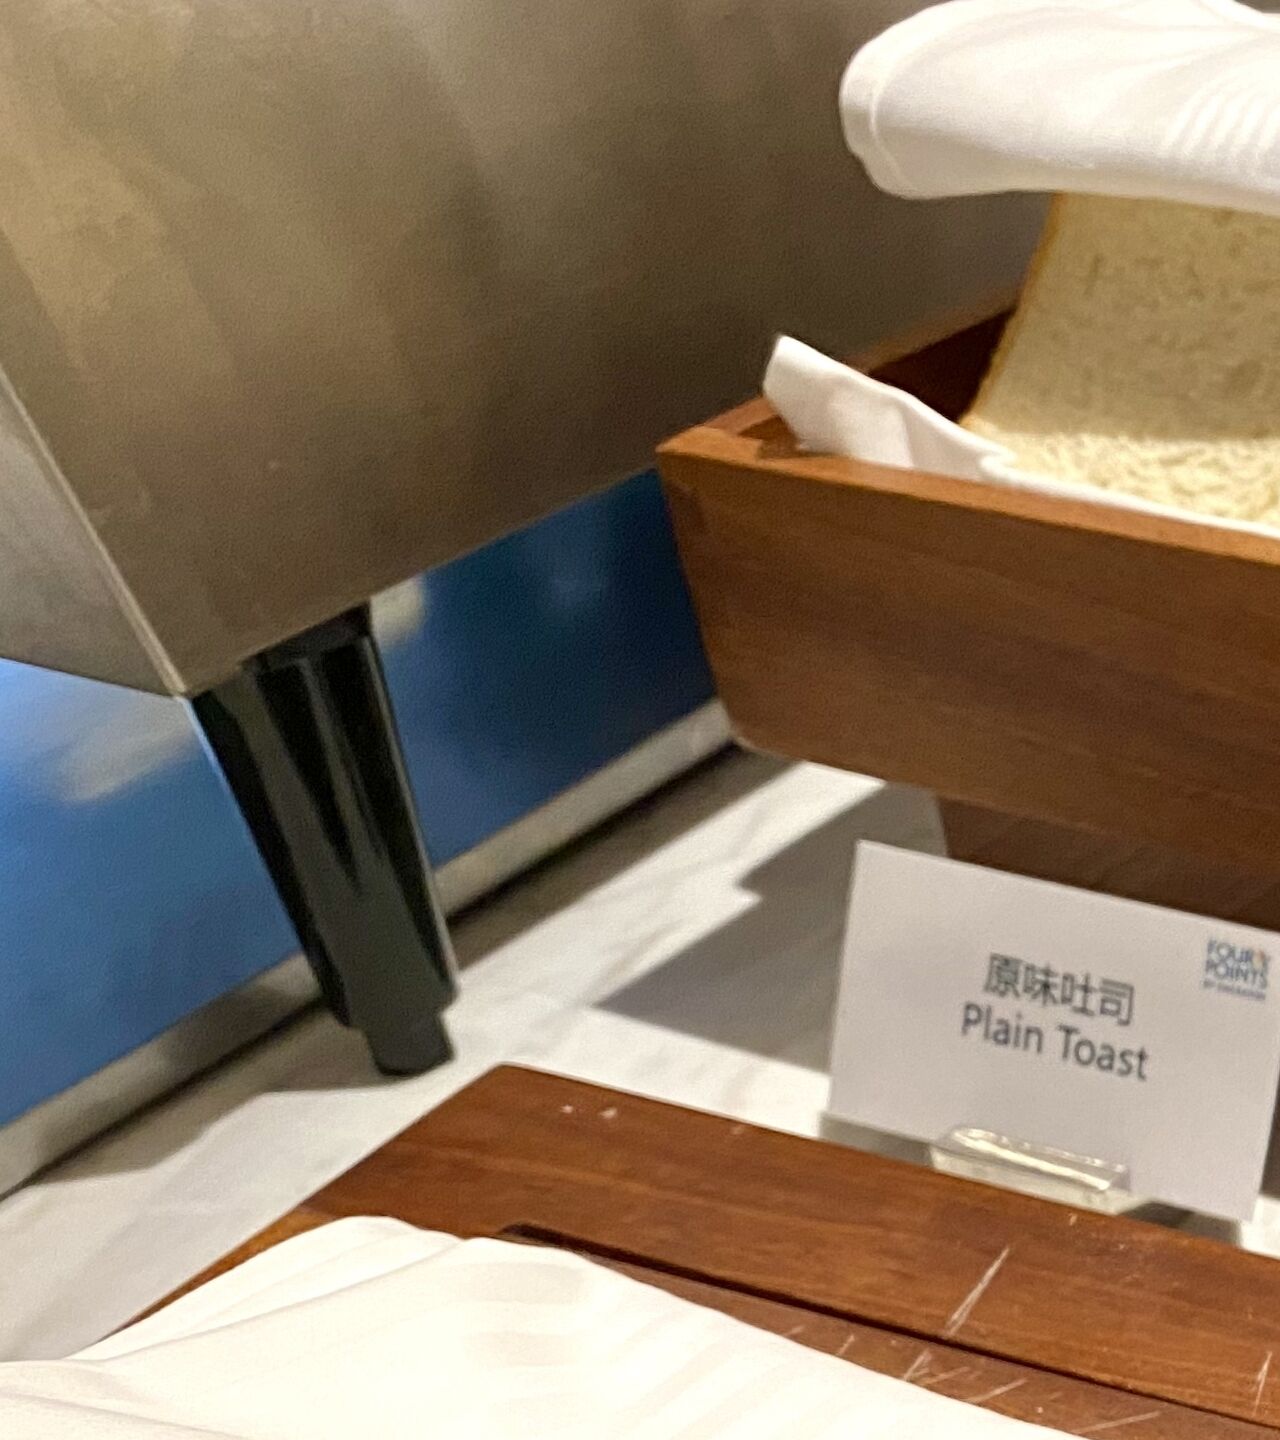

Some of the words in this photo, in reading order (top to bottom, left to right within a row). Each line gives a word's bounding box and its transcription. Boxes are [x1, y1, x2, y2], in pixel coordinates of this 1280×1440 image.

[1205, 958, 1268, 990] POINTS
[1206, 939, 1255, 963] FOUR
[983, 953, 1135, 1027] 原味吐司
[961, 1002, 1044, 1055] Plain
[1058, 1023, 1149, 1081] Toast
